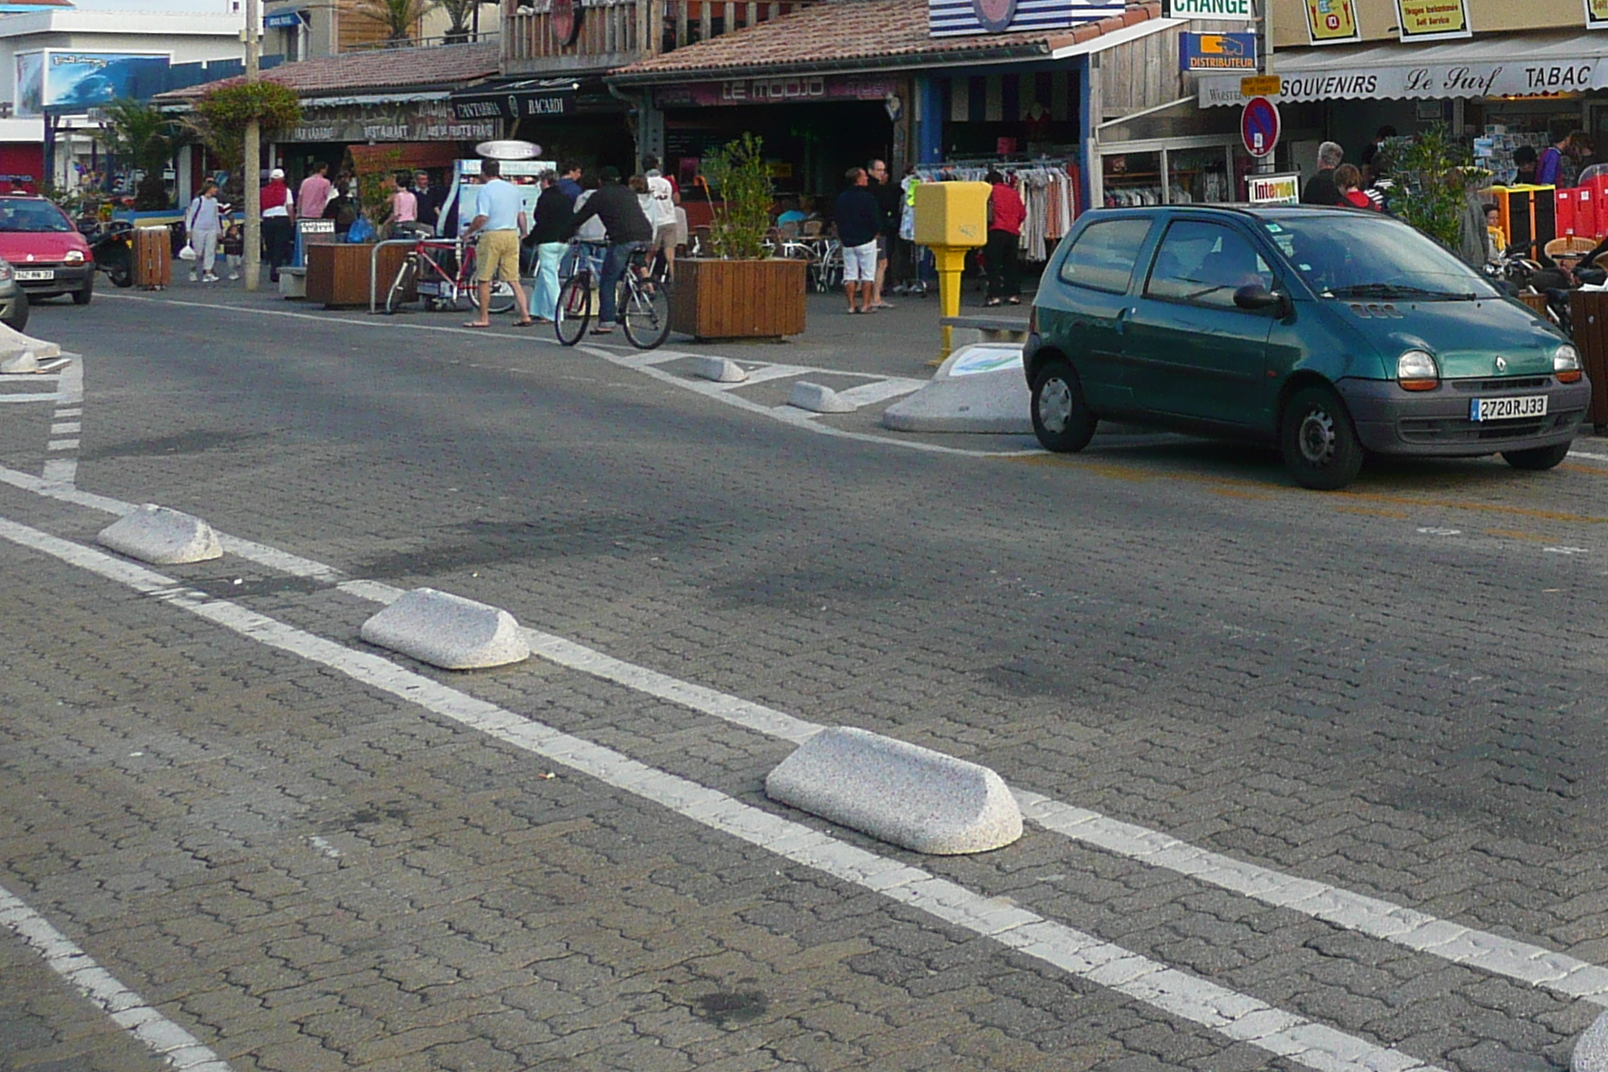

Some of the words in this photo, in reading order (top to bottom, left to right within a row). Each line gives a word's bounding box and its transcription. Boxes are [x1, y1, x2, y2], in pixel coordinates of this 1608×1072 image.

[1190, 56, 1254, 68] DISTRIBUTEUR
[1279, 75, 1378, 98] SOUVENIRS
[1403, 68, 1432, 92] Le
[1442, 66, 1504, 98] Surf
[1525, 65, 1592, 88] TABAC
[528, 98, 564, 115] BACARDI
[1254, 178, 1296, 200] Internet
